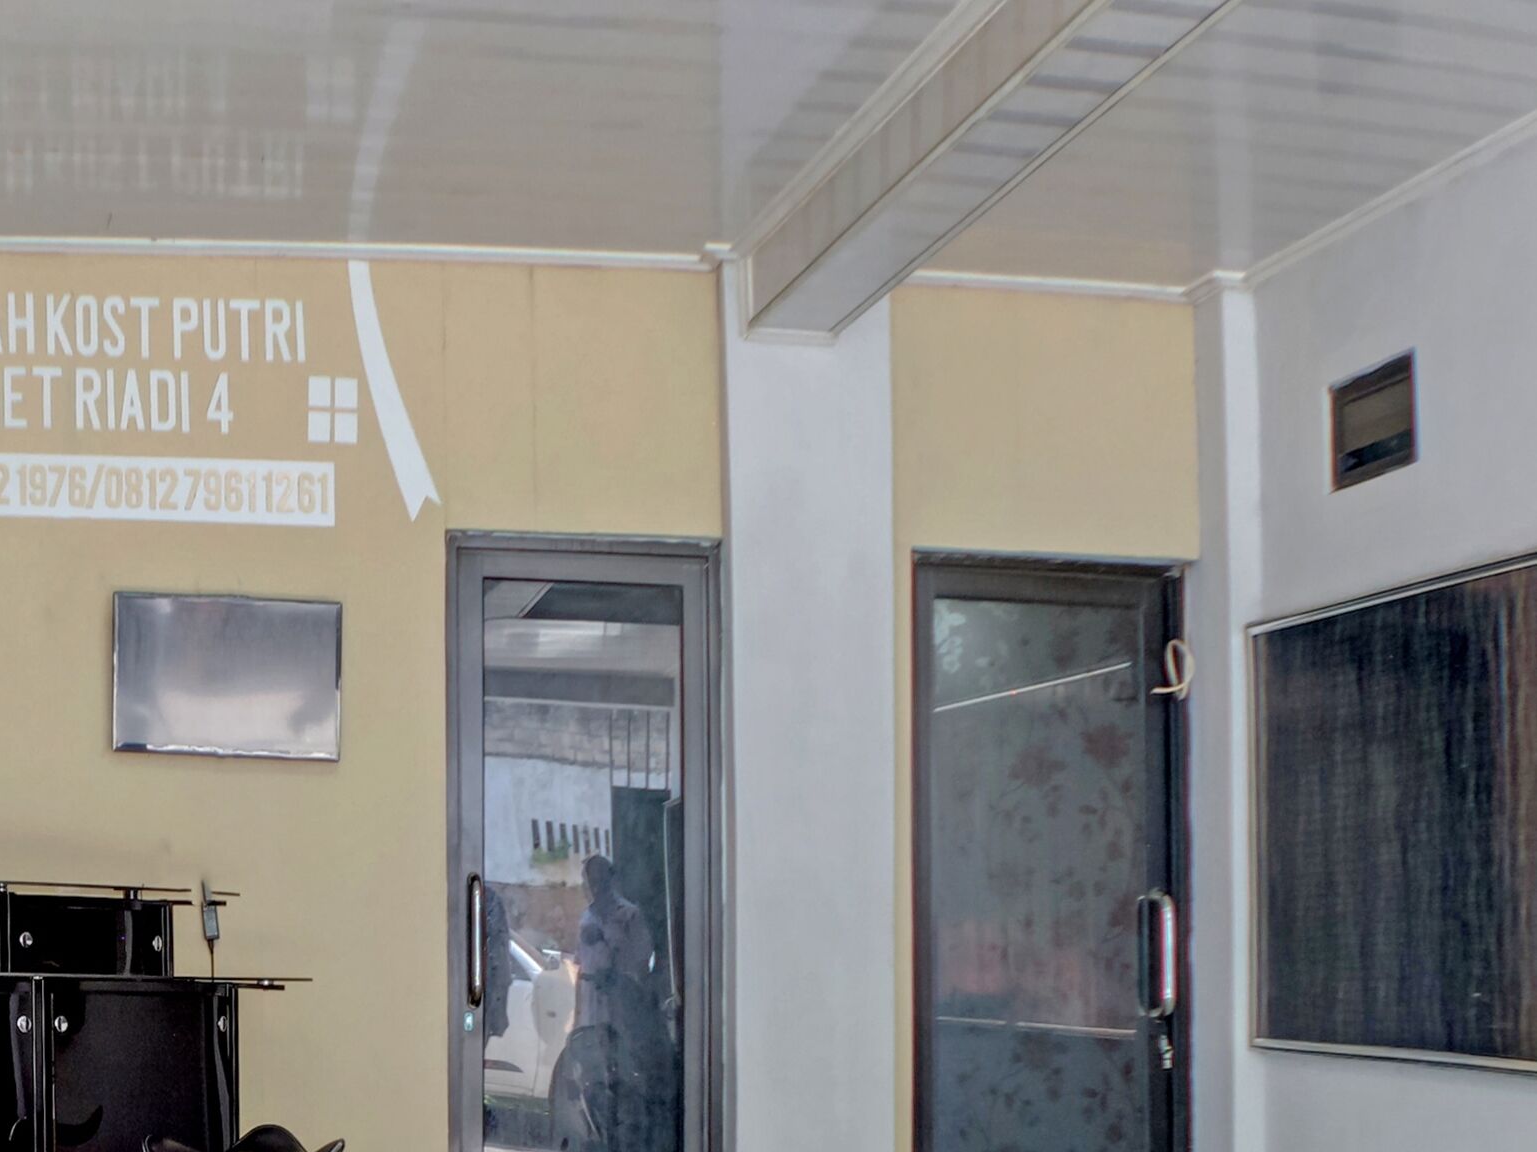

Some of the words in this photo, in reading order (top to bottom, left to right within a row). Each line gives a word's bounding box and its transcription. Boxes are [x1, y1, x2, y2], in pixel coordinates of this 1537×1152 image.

[45, 293, 160, 360] KOST
[172, 296, 307, 363] PUTRI
[75, 367, 191, 434] RIADI
[206, 372, 234, 435] 4
